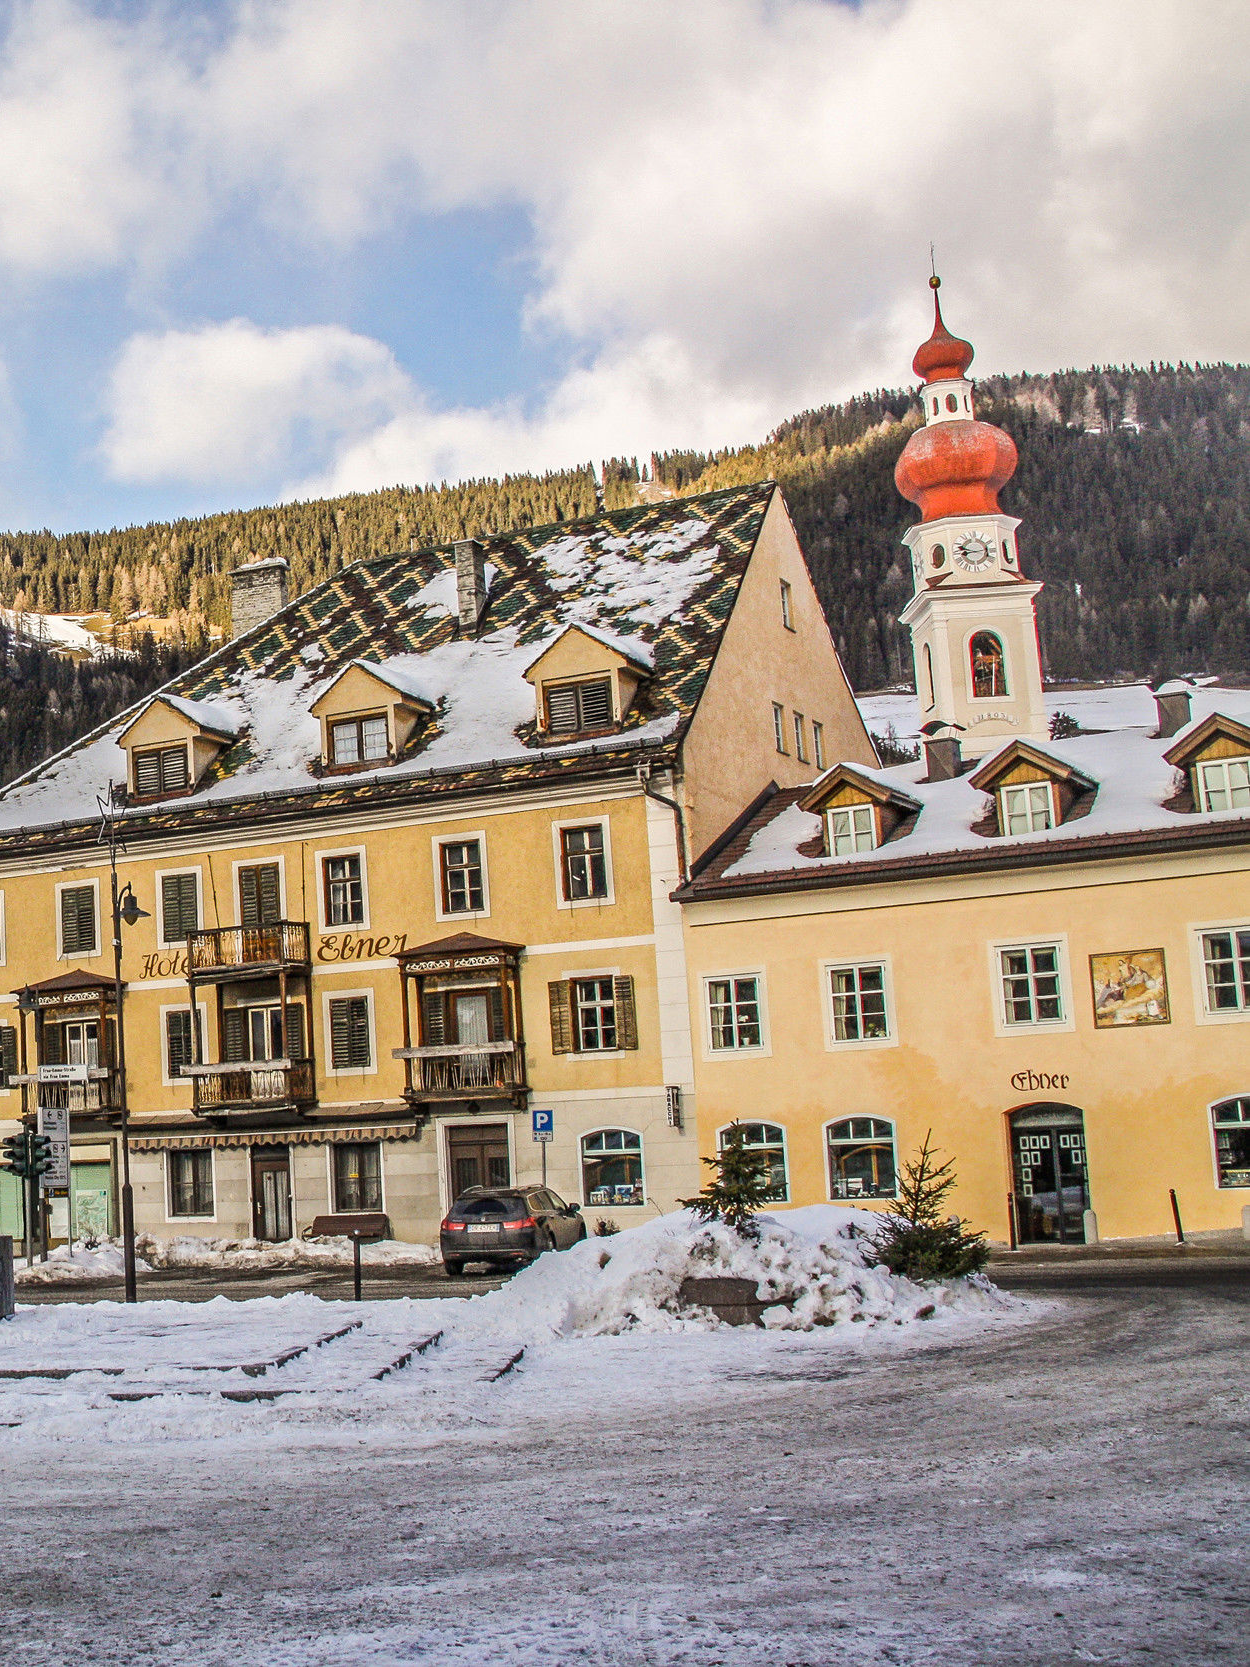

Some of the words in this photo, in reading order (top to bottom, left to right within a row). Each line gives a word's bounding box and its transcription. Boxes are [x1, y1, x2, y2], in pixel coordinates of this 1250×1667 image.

[317, 934, 408, 961] Ebner
[1011, 1069, 1069, 1091] Ebner
[536, 1112, 549, 1129] P
